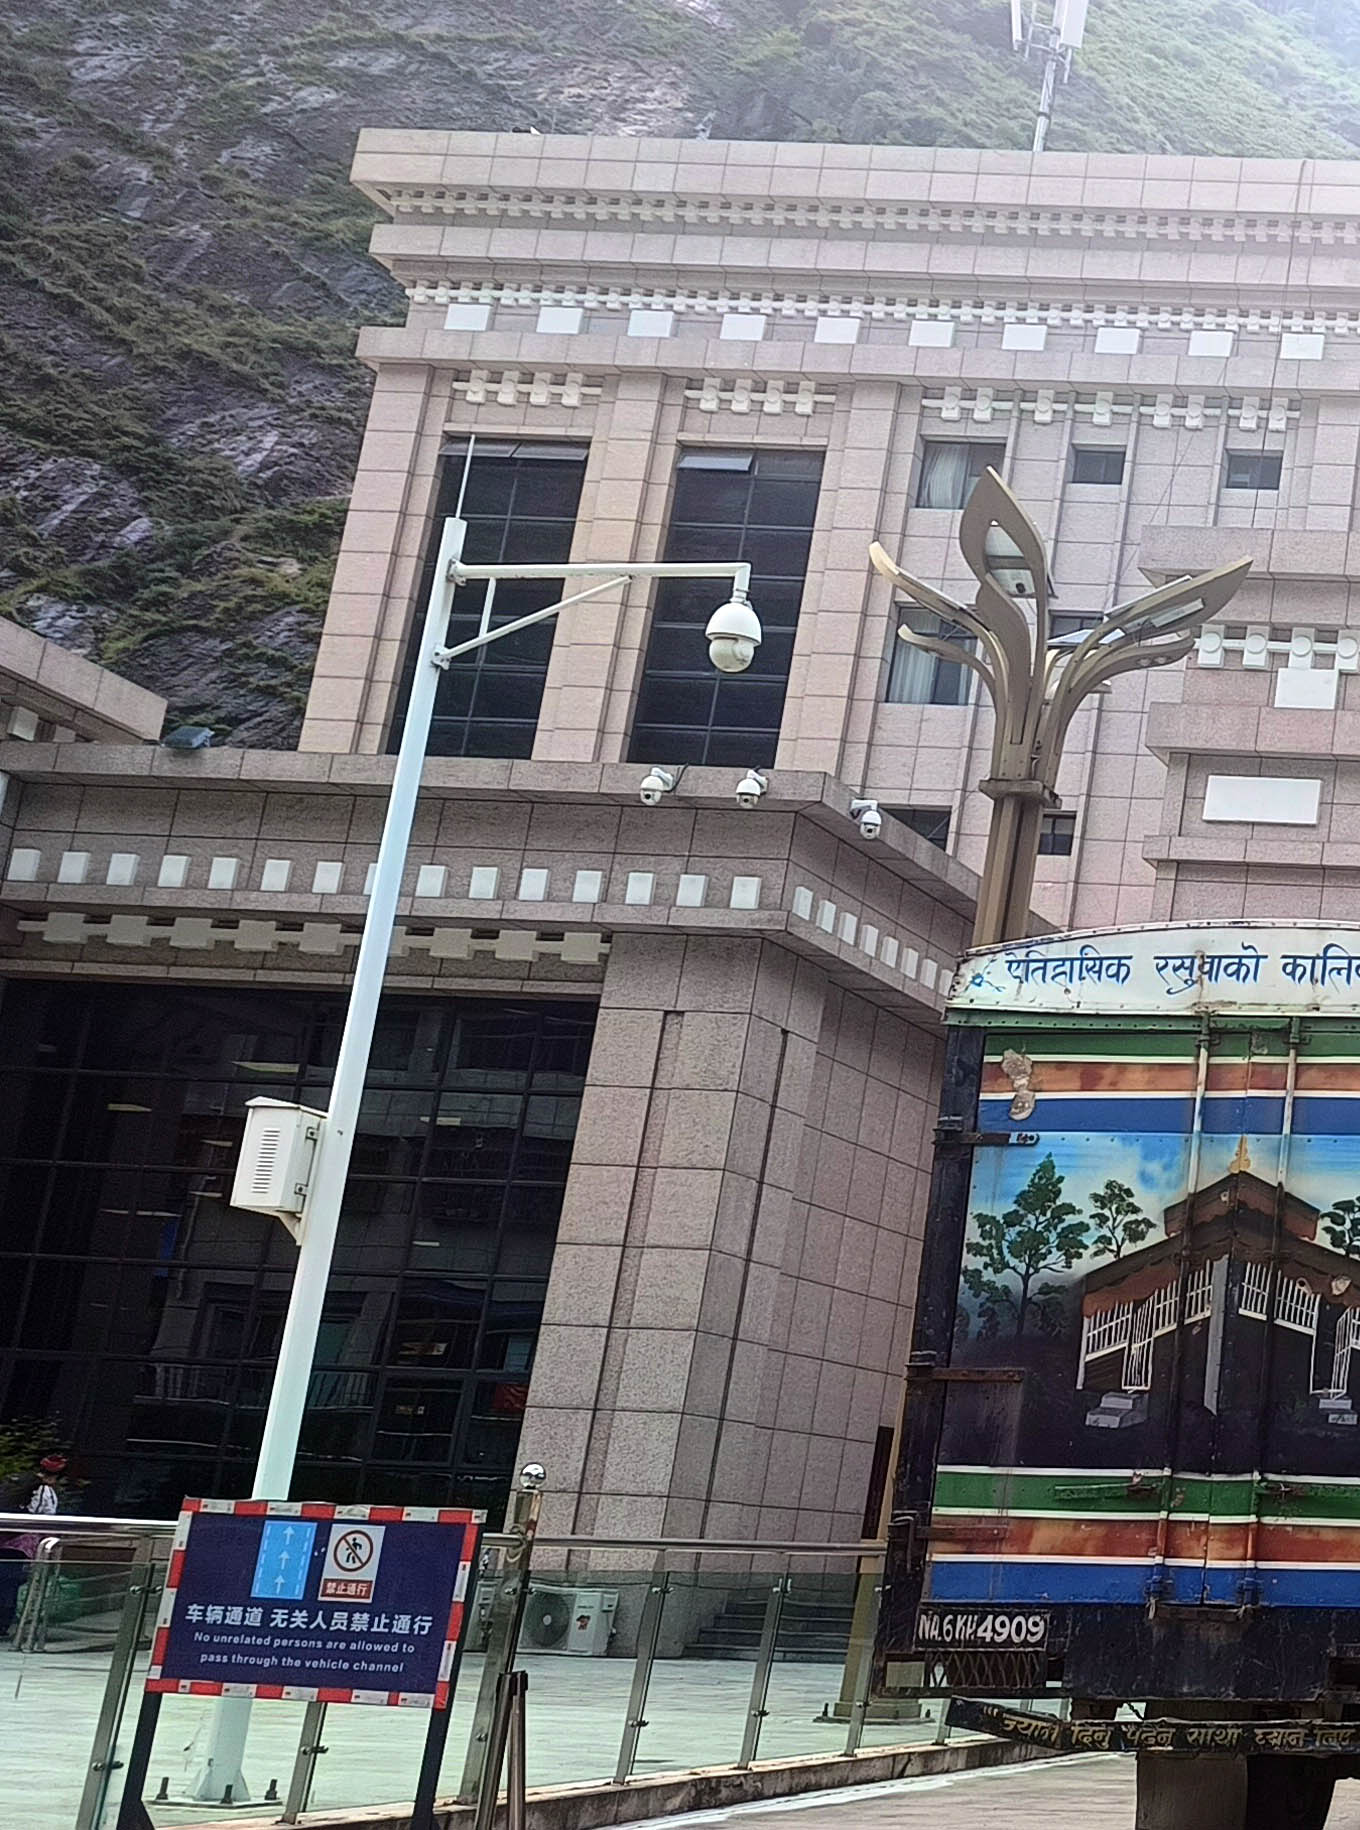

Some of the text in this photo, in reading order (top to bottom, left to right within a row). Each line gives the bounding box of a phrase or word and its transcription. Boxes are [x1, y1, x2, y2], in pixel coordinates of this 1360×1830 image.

[1004, 945, 1133, 986] ऐतिहासिक
[1153, 942, 1268, 995] रसुवाको
[325, 1582, 368, 1596] 禁止通行
[185, 1603, 433, 1635] 车辆通道 无关人员禁止通行
[194, 1631, 415, 1654] No unrelated persons are allowed to
[200, 1653, 404, 1673] pass through the vehicle channel
